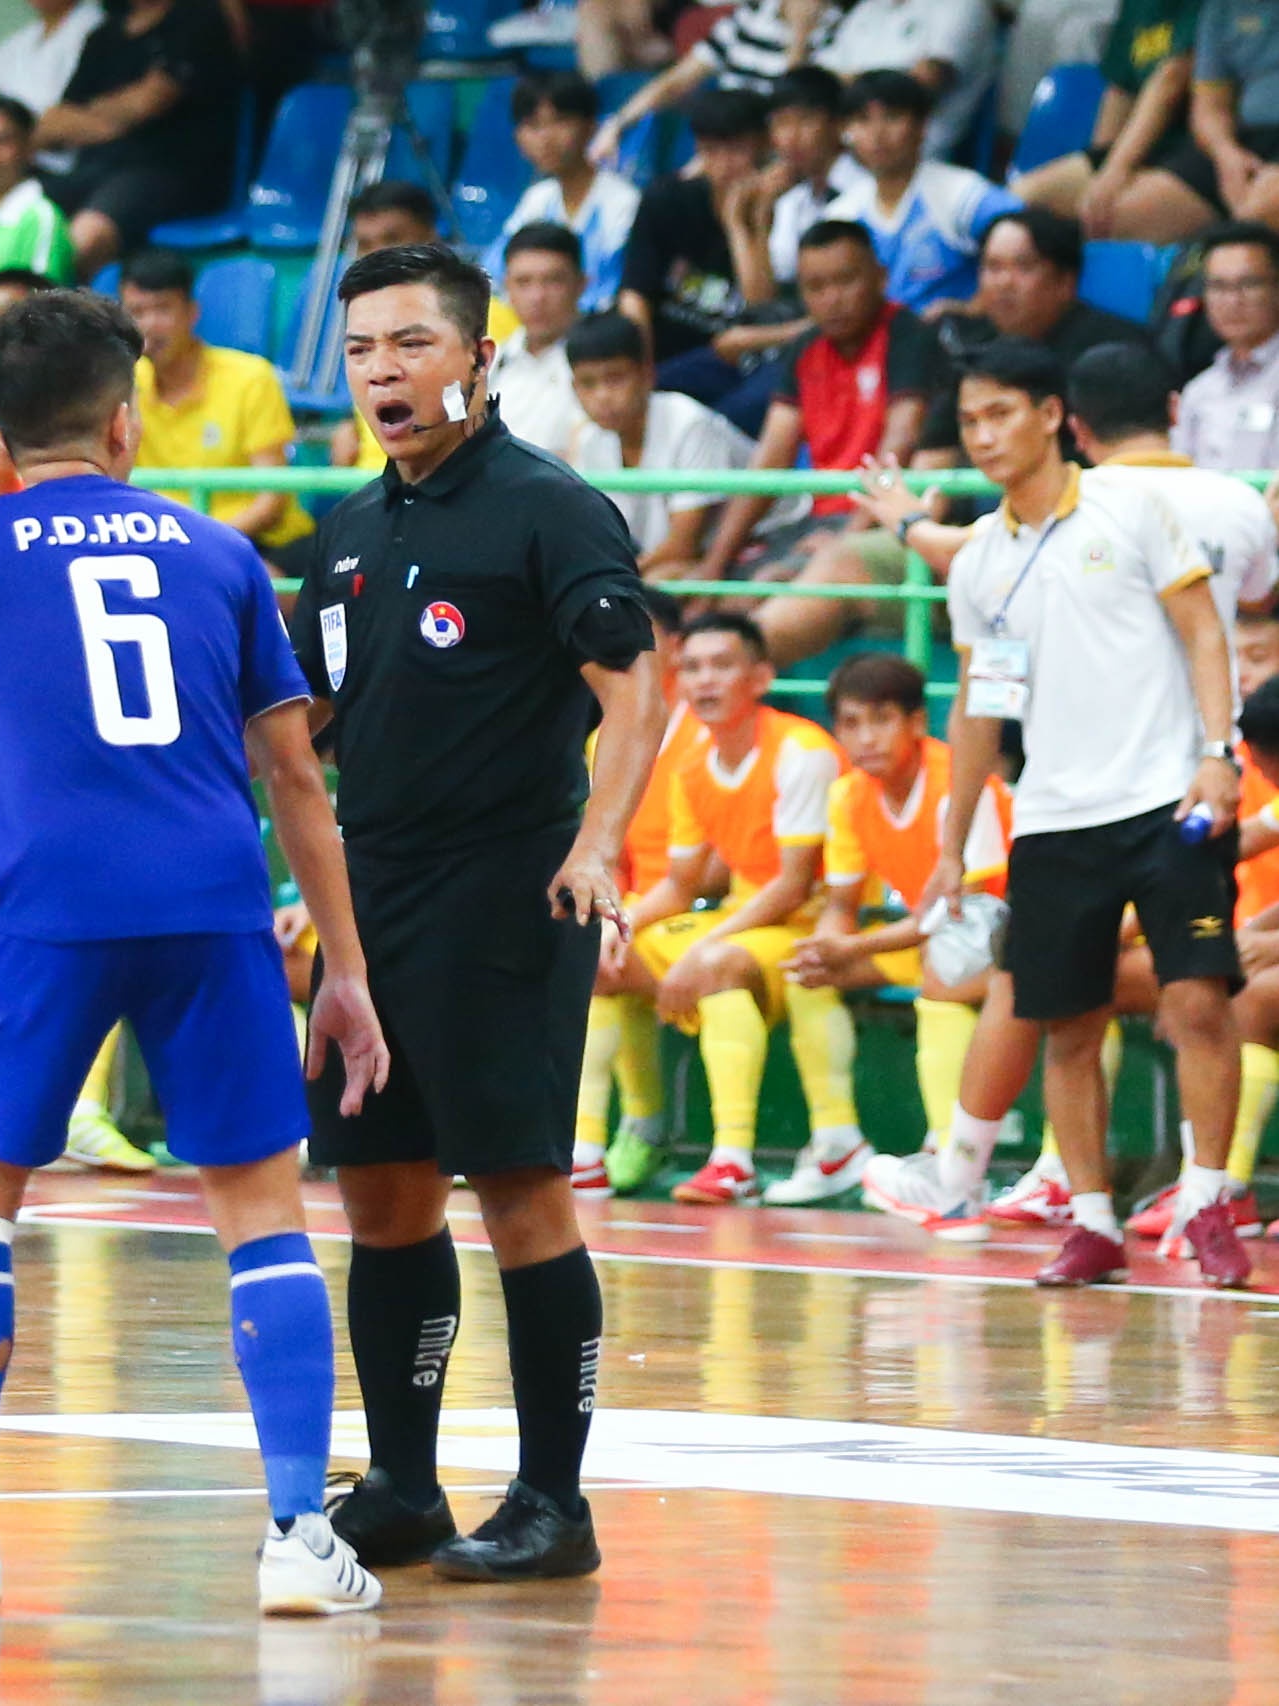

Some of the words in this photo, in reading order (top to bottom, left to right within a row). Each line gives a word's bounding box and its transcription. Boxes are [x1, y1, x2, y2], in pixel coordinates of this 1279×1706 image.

[13, 511, 191, 552] P.D.HOA
[68, 554, 181, 746] 6
[323, 609, 343, 635] FIFA
[412, 1314, 457, 1387] mitre
[577, 1336, 602, 1413] mitre
